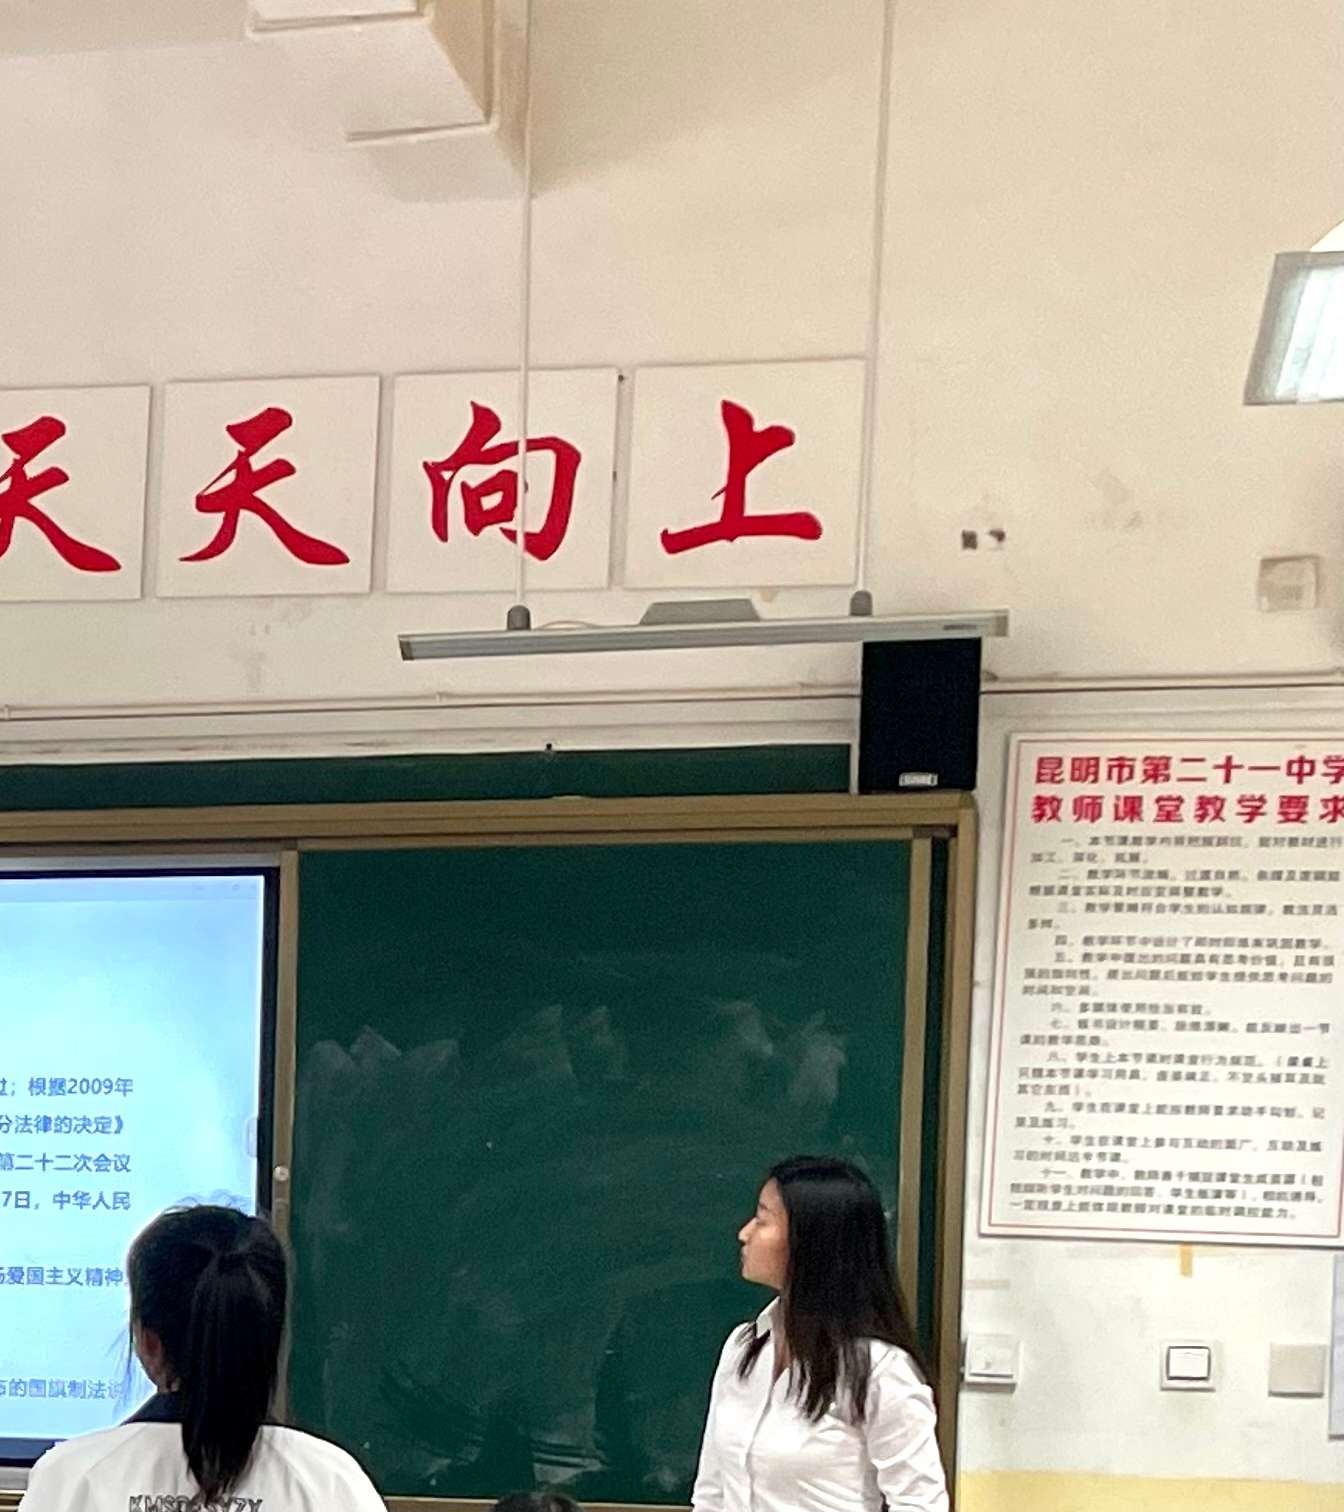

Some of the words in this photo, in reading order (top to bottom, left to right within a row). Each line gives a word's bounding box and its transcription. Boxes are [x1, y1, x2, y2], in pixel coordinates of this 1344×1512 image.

[1035, 755, 1344, 784] 昆明市第二十一中学
[1032, 794, 1344, 824] 教师课堂教学要求
